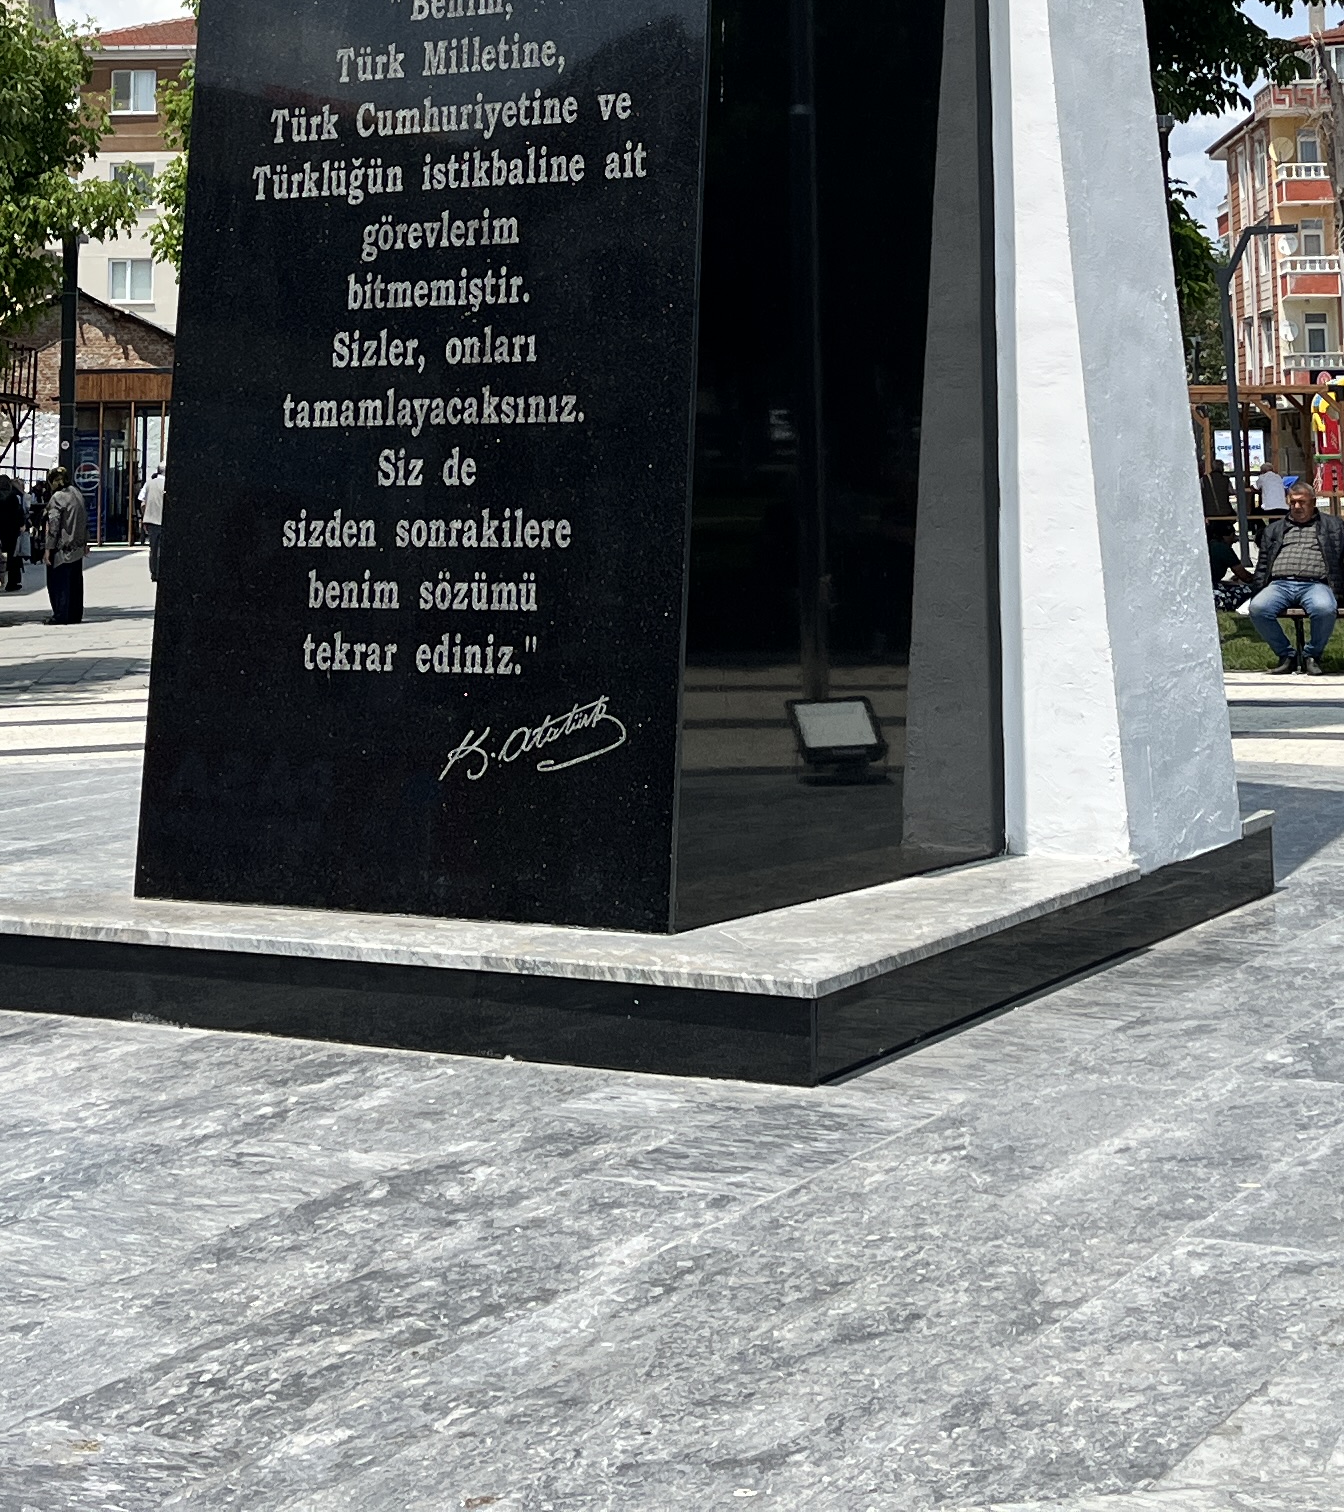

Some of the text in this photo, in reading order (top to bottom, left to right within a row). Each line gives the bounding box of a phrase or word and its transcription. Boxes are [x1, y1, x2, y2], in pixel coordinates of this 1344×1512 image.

[336, 32, 566, 83] Türk Milletine,
[270, 88, 632, 144] Türk Cumhuriyetine ve
[252, 140, 648, 205] Türklüğün istikbaline ait
[361, 207, 520, 262] görevlerim
[347, 266, 530, 312] bitmemiştir.
[332, 326, 537, 373] Sizler, onları
[282, 385, 586, 437] tamamlayacaksınız.
[377, 447, 477, 487] Siz de
[282, 507, 572, 548] sizden sonrakilere
[308, 569, 538, 612] benim sözümü
[302, 631, 538, 675] tekrar ediniz."
